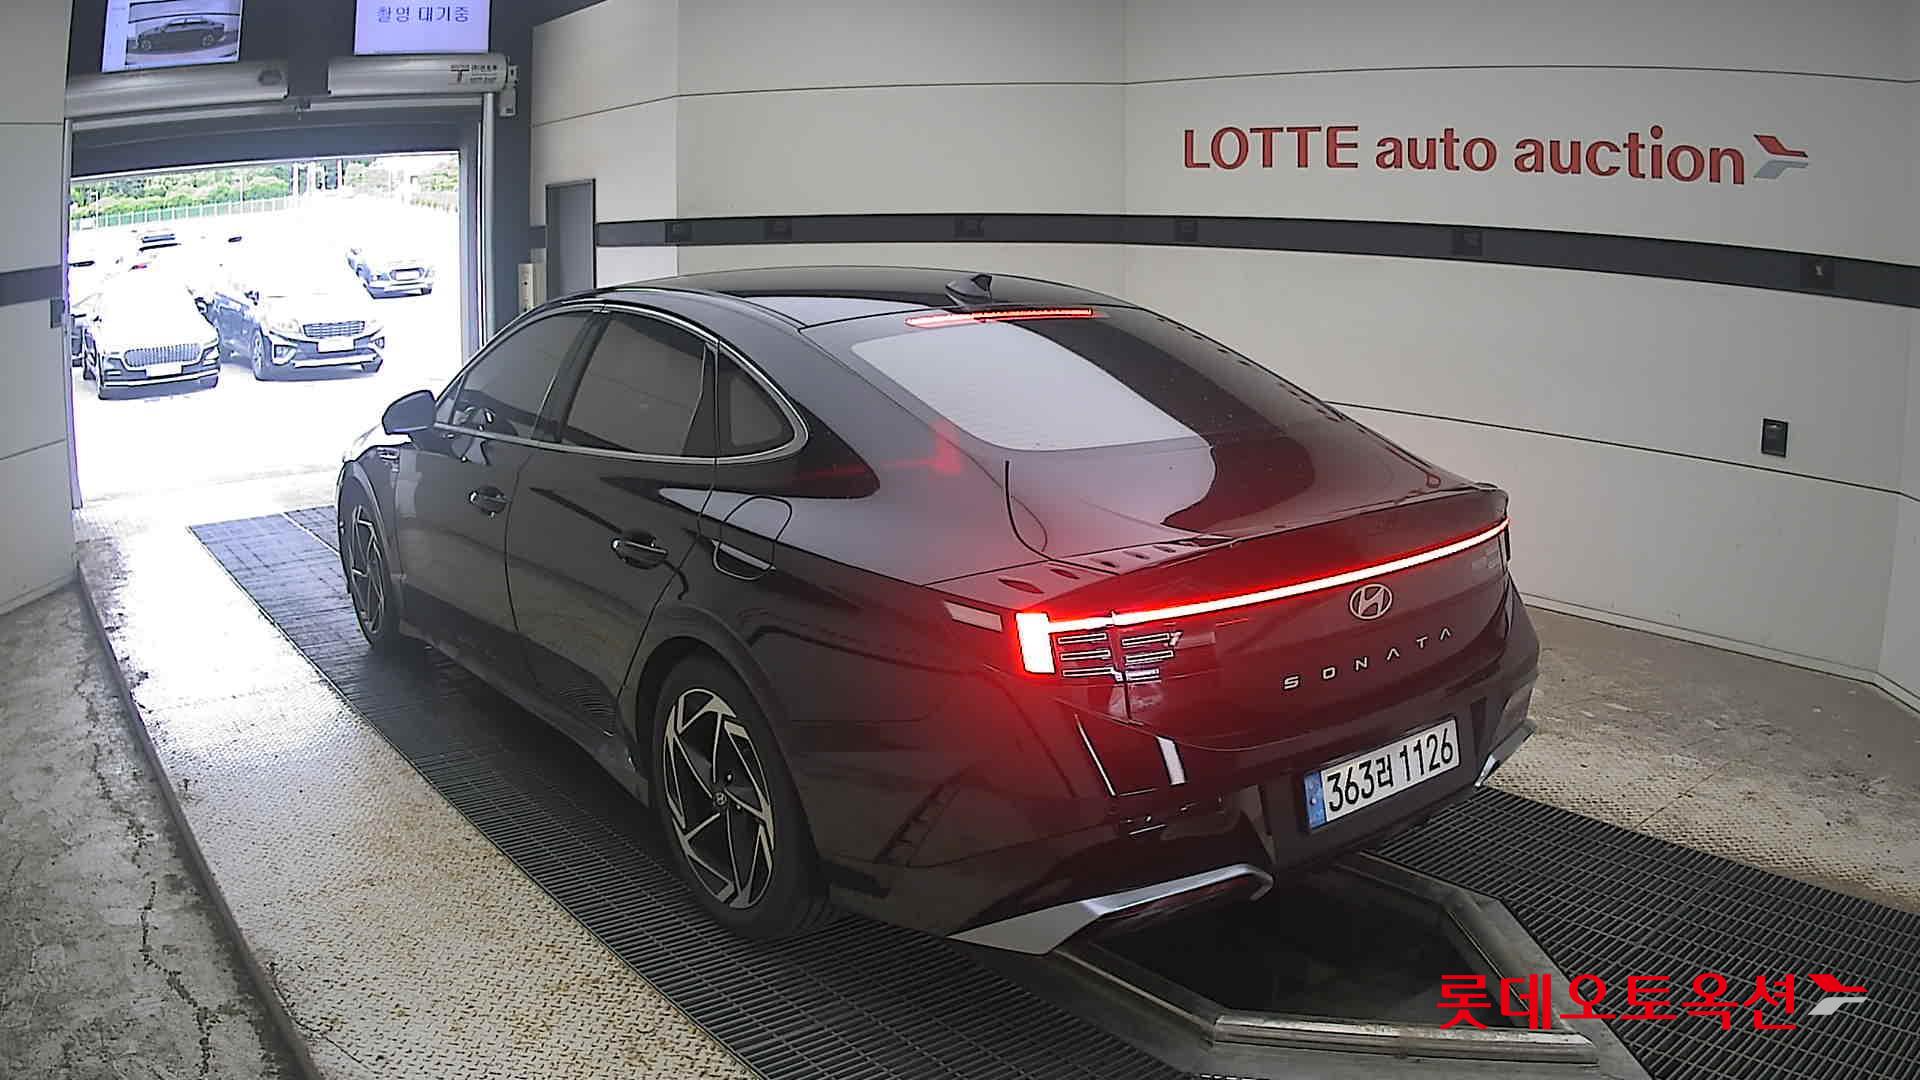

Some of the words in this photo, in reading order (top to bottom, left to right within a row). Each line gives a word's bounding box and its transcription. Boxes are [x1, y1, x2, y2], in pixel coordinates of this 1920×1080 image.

[1184, 125, 1360, 170] LOTTE
[1375, 127, 1498, 172] auto
[1513, 125, 1745, 185] auction
[1283, 627, 1453, 690] SONATA
[1326, 753, 1395, 812] 363러
[1399, 727, 1454, 782] 1126
